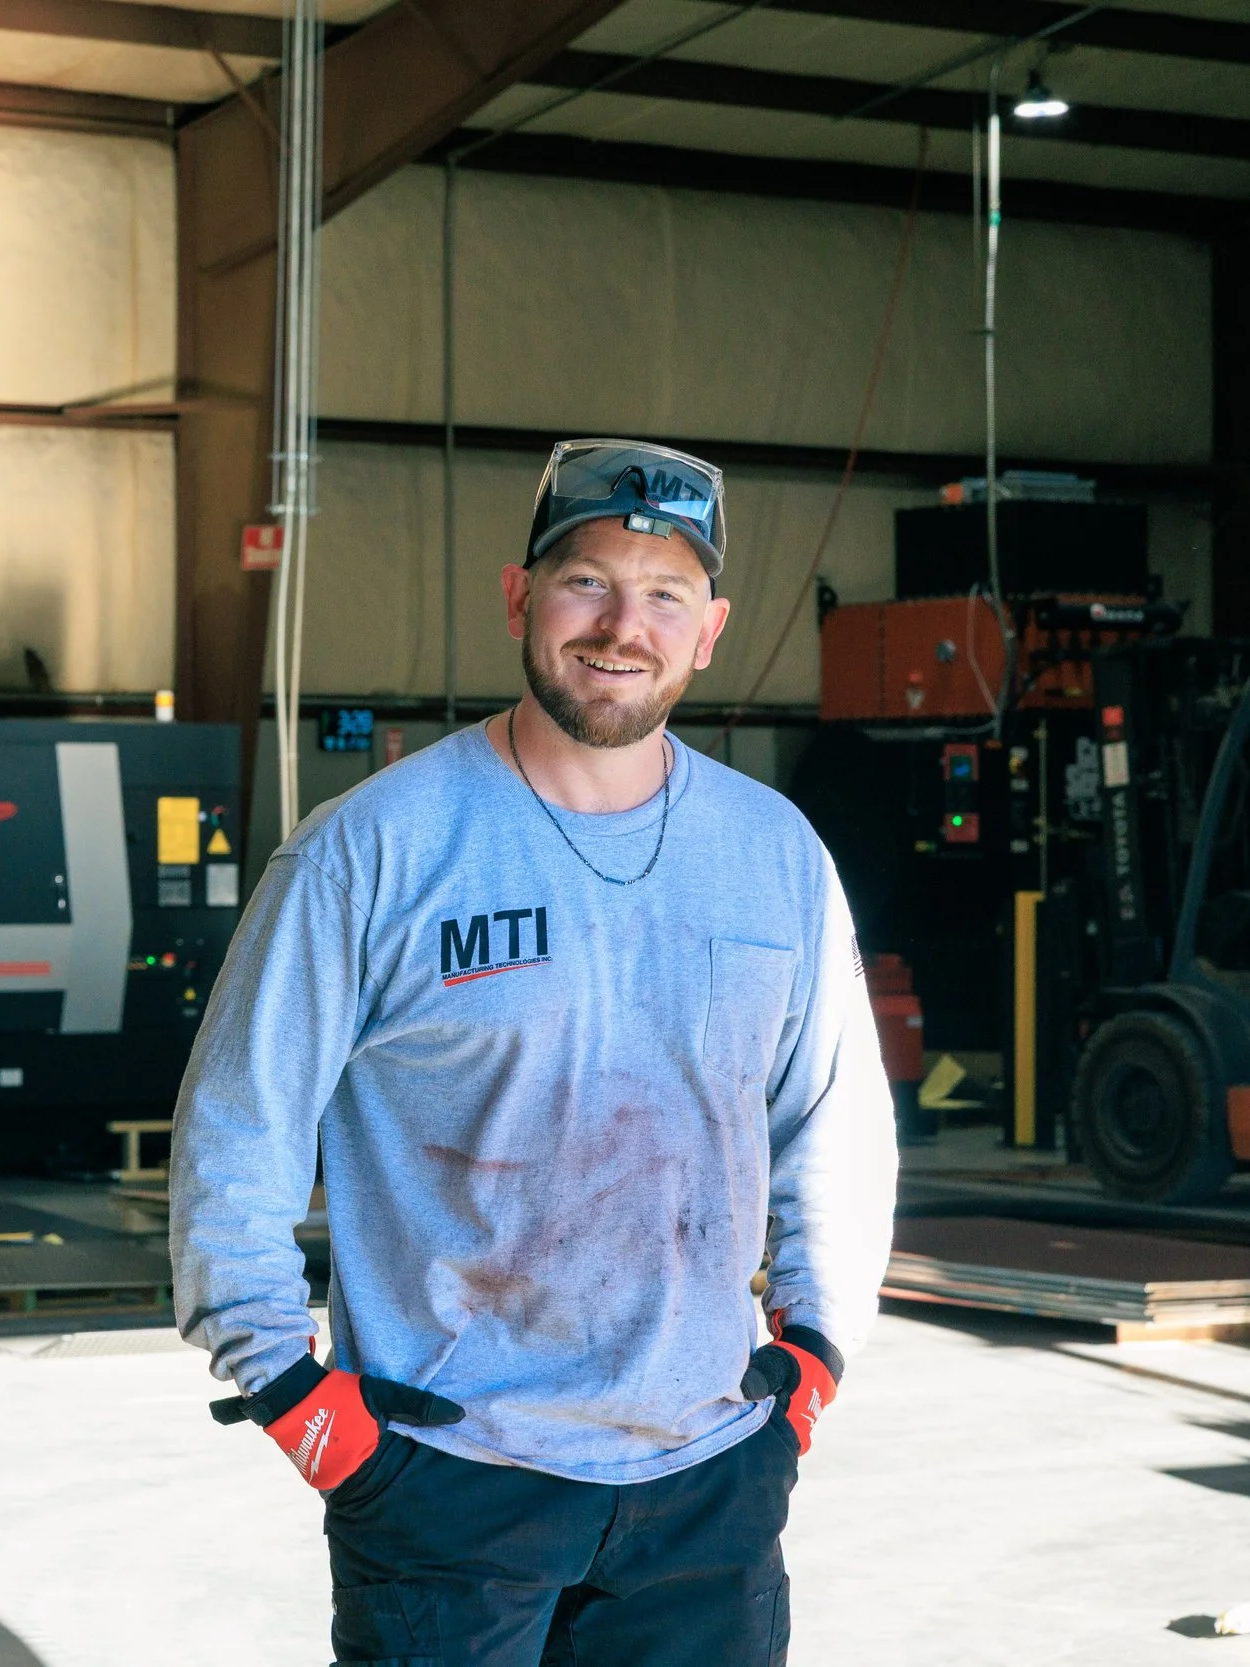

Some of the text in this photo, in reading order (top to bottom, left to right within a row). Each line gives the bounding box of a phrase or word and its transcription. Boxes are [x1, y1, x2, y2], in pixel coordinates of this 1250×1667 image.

[650, 469, 709, 509] MT
[441, 907, 547, 974] MTI
[442, 964, 494, 980] MANUFACTURING
[495, 956, 541, 970] TECHNOLOGIES
[287, 1408, 329, 1476] Milwaukee
